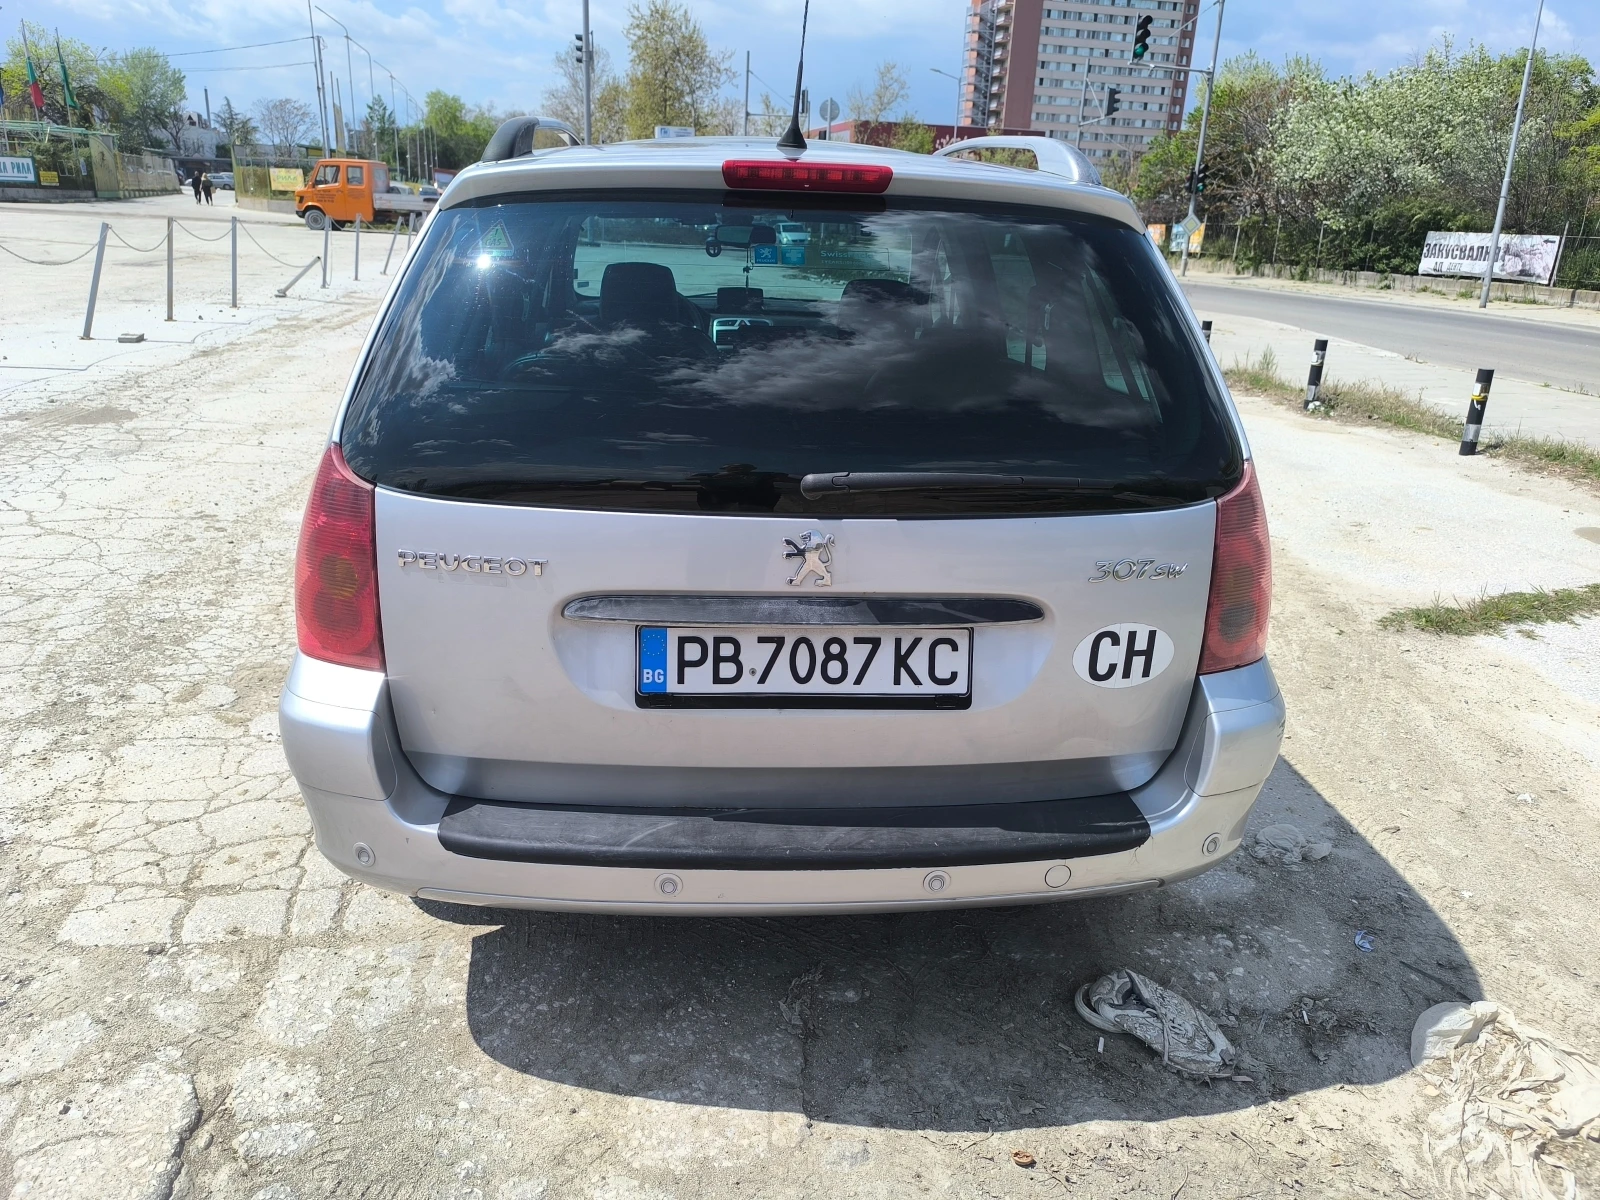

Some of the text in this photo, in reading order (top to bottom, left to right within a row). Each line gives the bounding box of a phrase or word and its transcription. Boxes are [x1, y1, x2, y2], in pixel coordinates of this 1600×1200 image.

[10, 161, 32, 175] РИЛА
[397, 549, 549, 577] PEUGEOT
[756, 636, 882, 686] 7087
[1087, 629, 1158, 682] CH
[642, 668, 665, 684] BG
